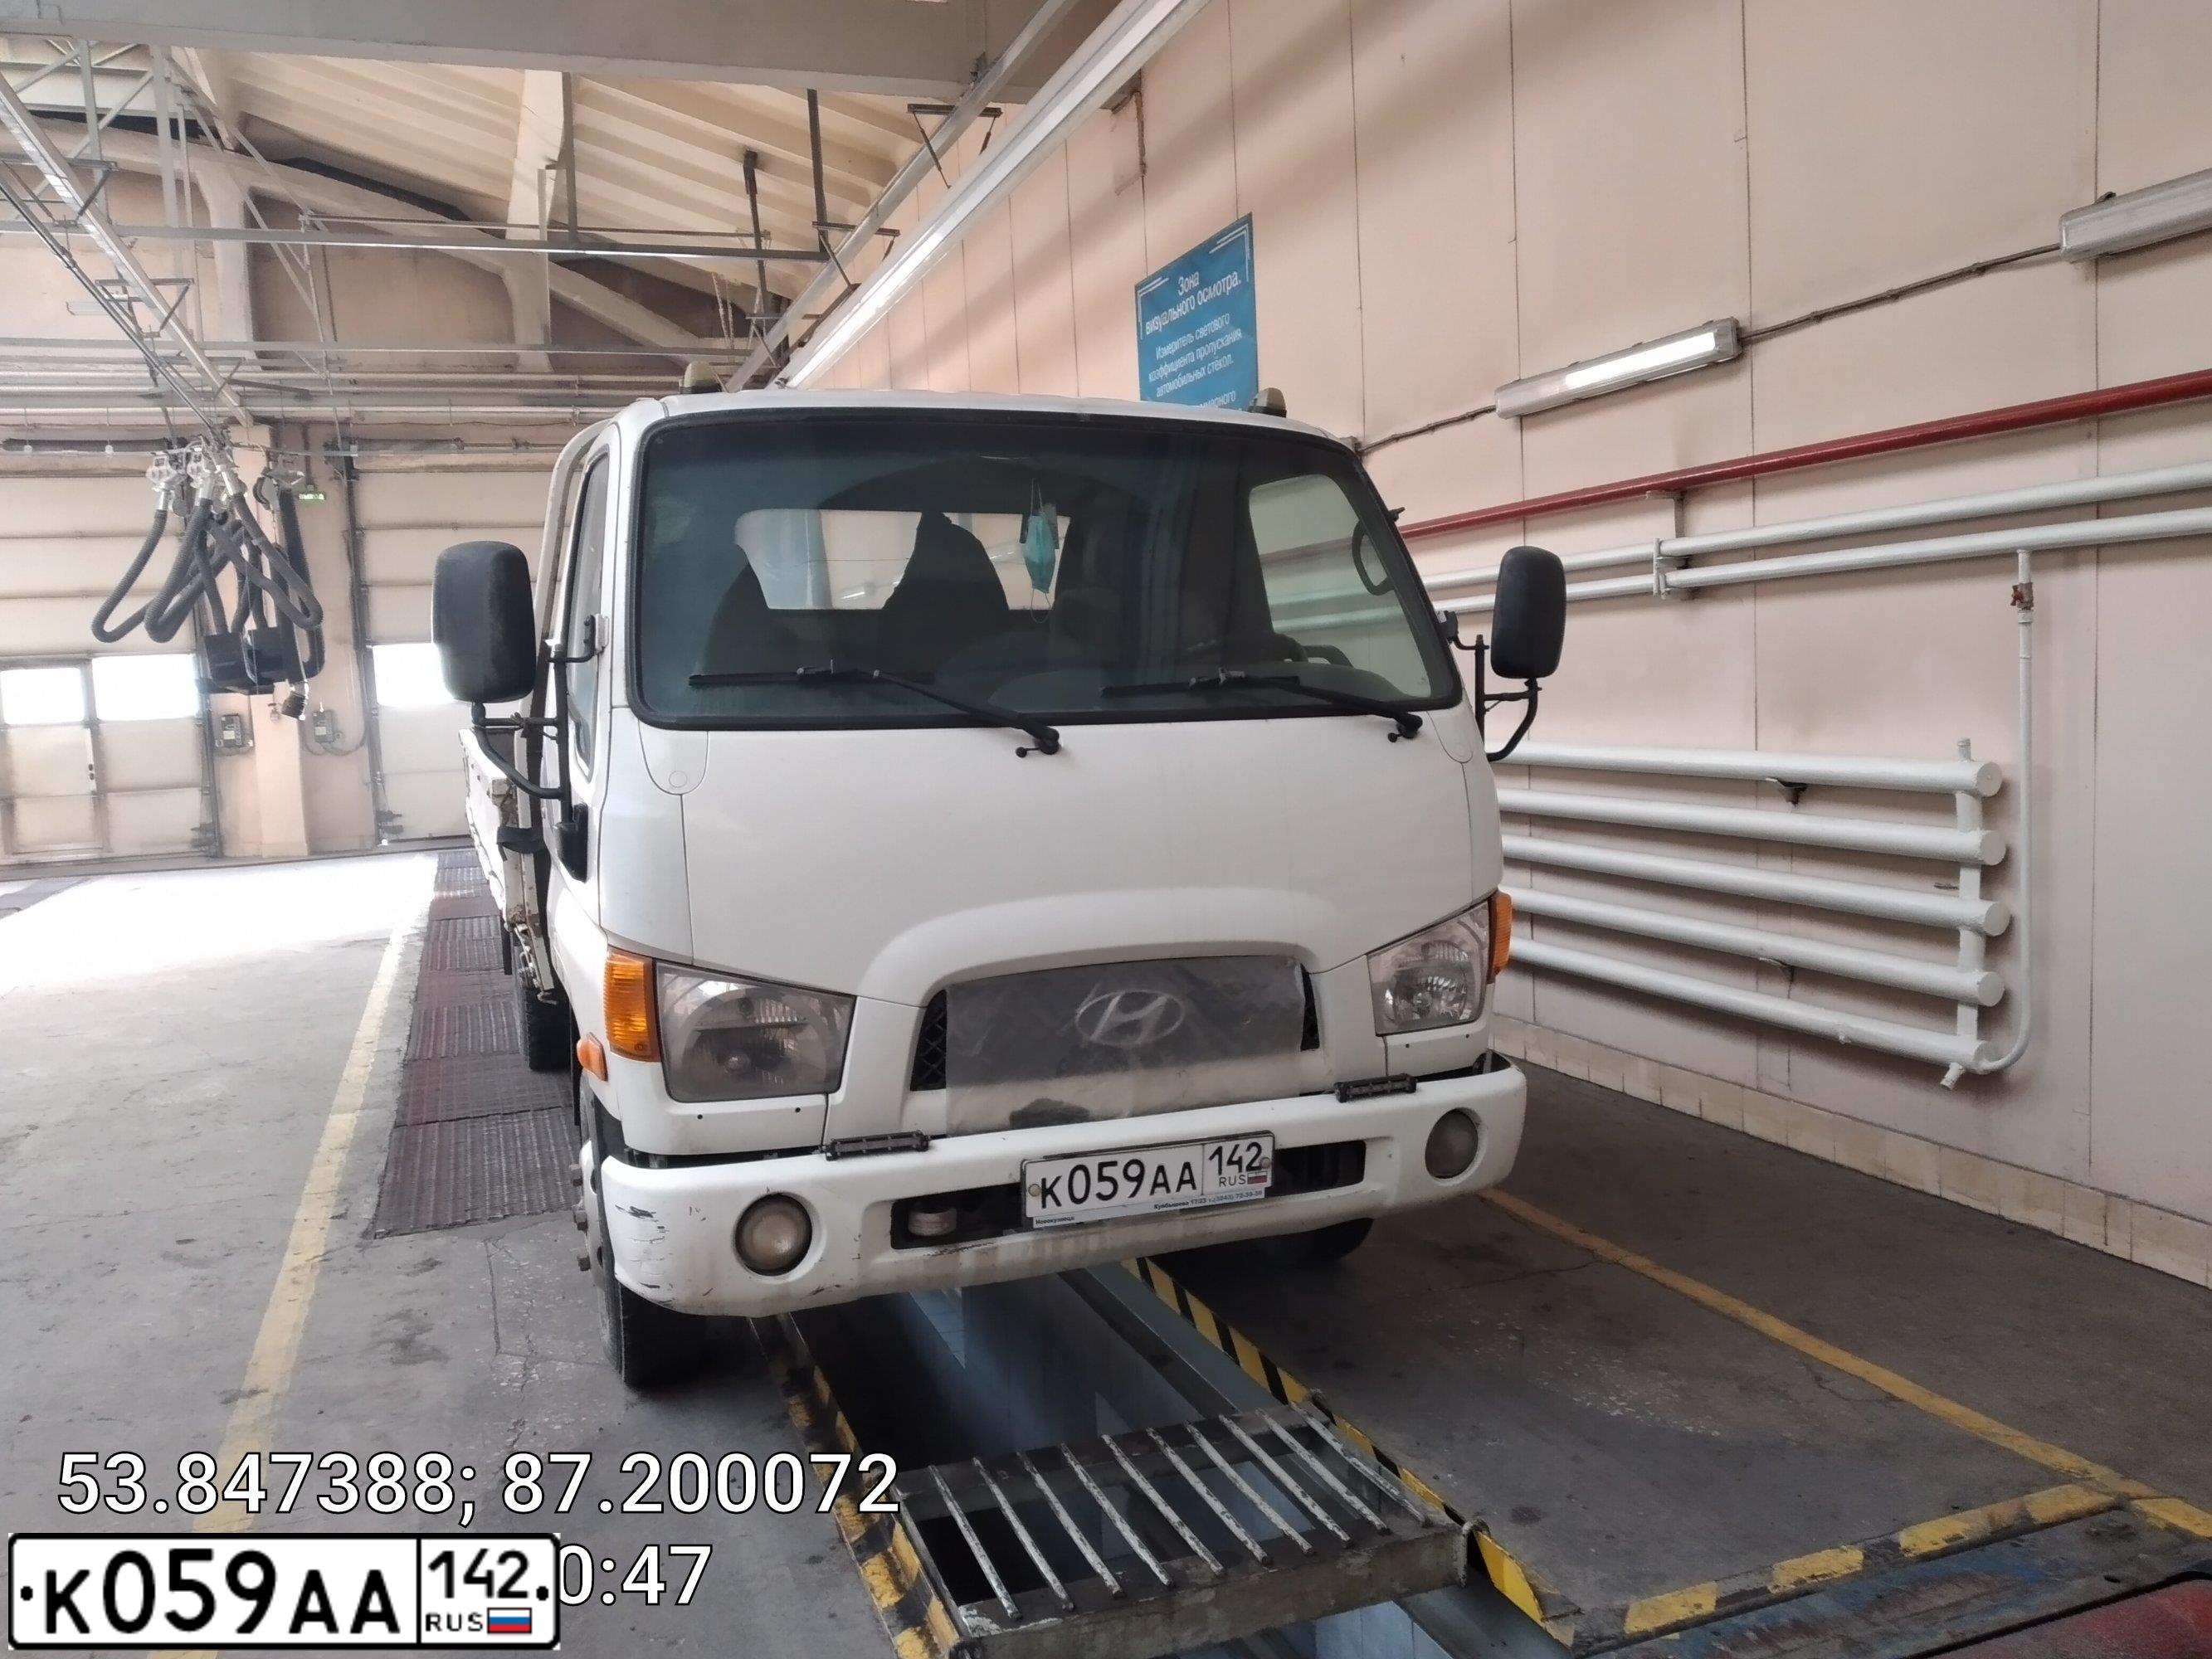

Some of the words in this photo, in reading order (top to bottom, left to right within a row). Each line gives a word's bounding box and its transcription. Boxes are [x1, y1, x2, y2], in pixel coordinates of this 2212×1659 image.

[1145, 295, 1196, 335] визуального
[1197, 271, 1241, 306] осмотра.
[1177, 271, 1200, 296] Зона
[1148, 351, 1195, 382] коэффициента
[1196, 328, 1243, 361] пропускания
[1156, 333, 1195, 360] Измеритель
[1195, 313, 1230, 340] светового
[1156, 366, 1206, 397] автомобильных
[1040, 1158, 1197, 1209] К059АА
[1208, 1141, 1264, 1176] 142
[1218, 1174, 1246, 1187] RUS
